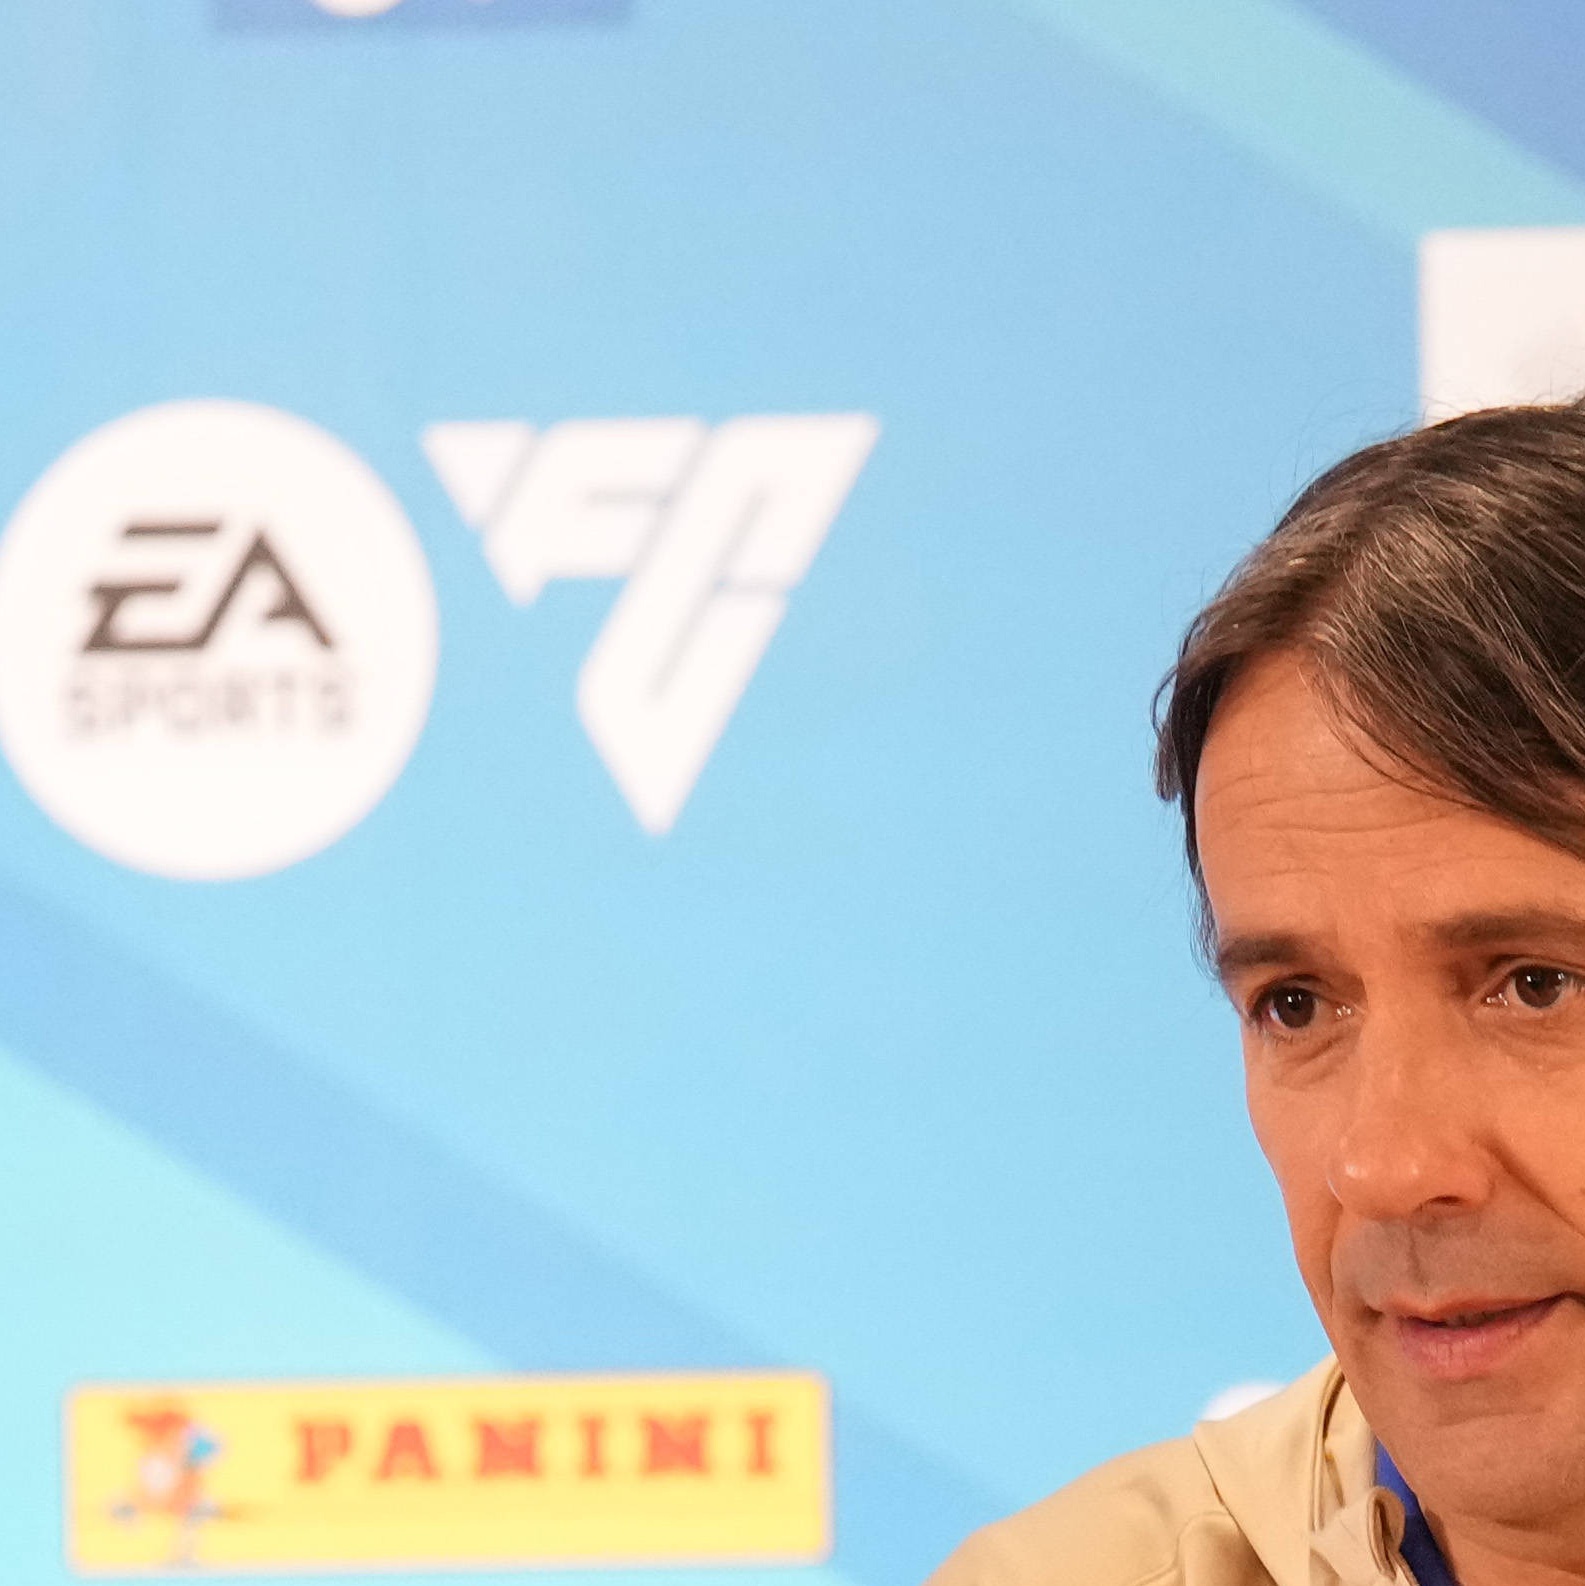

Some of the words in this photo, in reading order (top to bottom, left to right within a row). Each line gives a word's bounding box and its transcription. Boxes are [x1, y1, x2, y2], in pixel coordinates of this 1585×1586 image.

[81, 521, 337, 655] EA
[61, 671, 358, 741] SPORTS
[293, 1411, 777, 1485] PANINI
